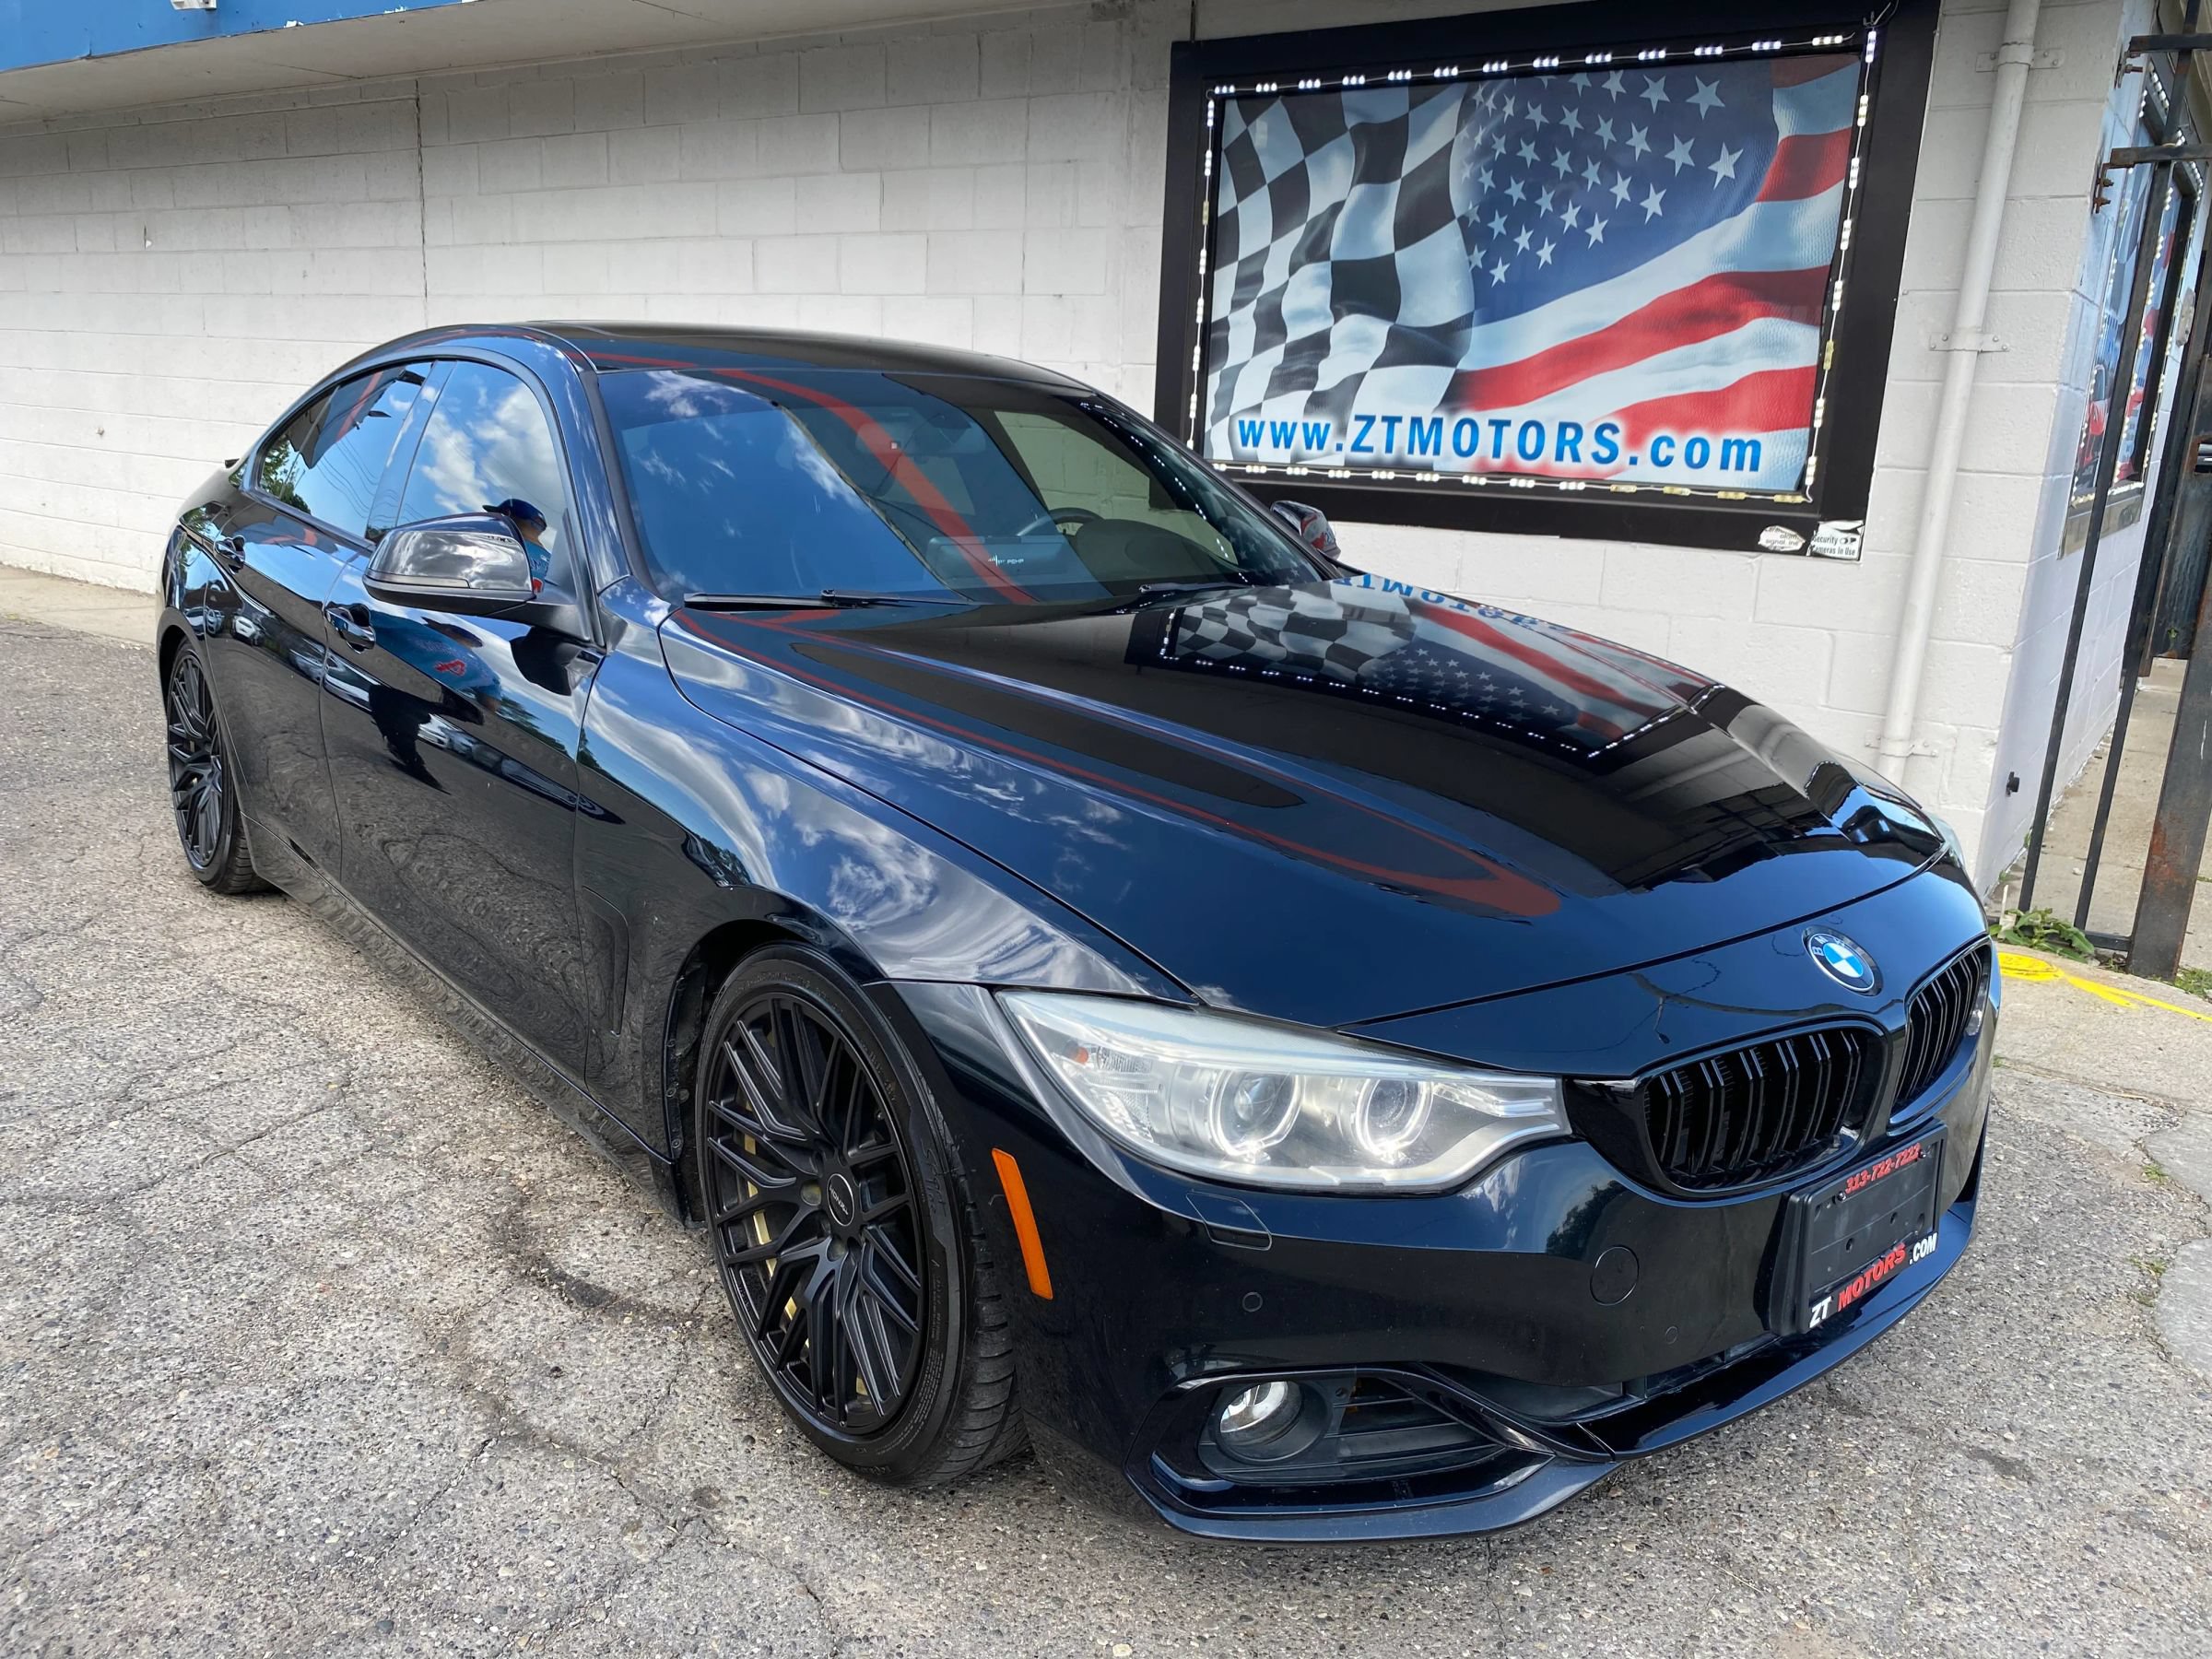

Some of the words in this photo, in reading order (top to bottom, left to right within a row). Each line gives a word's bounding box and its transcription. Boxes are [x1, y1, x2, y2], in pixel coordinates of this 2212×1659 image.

[1238, 415, 1761, 472] www.ZTMOTORS.com
[1845, 1142, 1922, 1194] 313-722-7222
[1809, 1295, 1832, 1329] ZT
[1837, 1241, 1907, 1312] MOTORS
